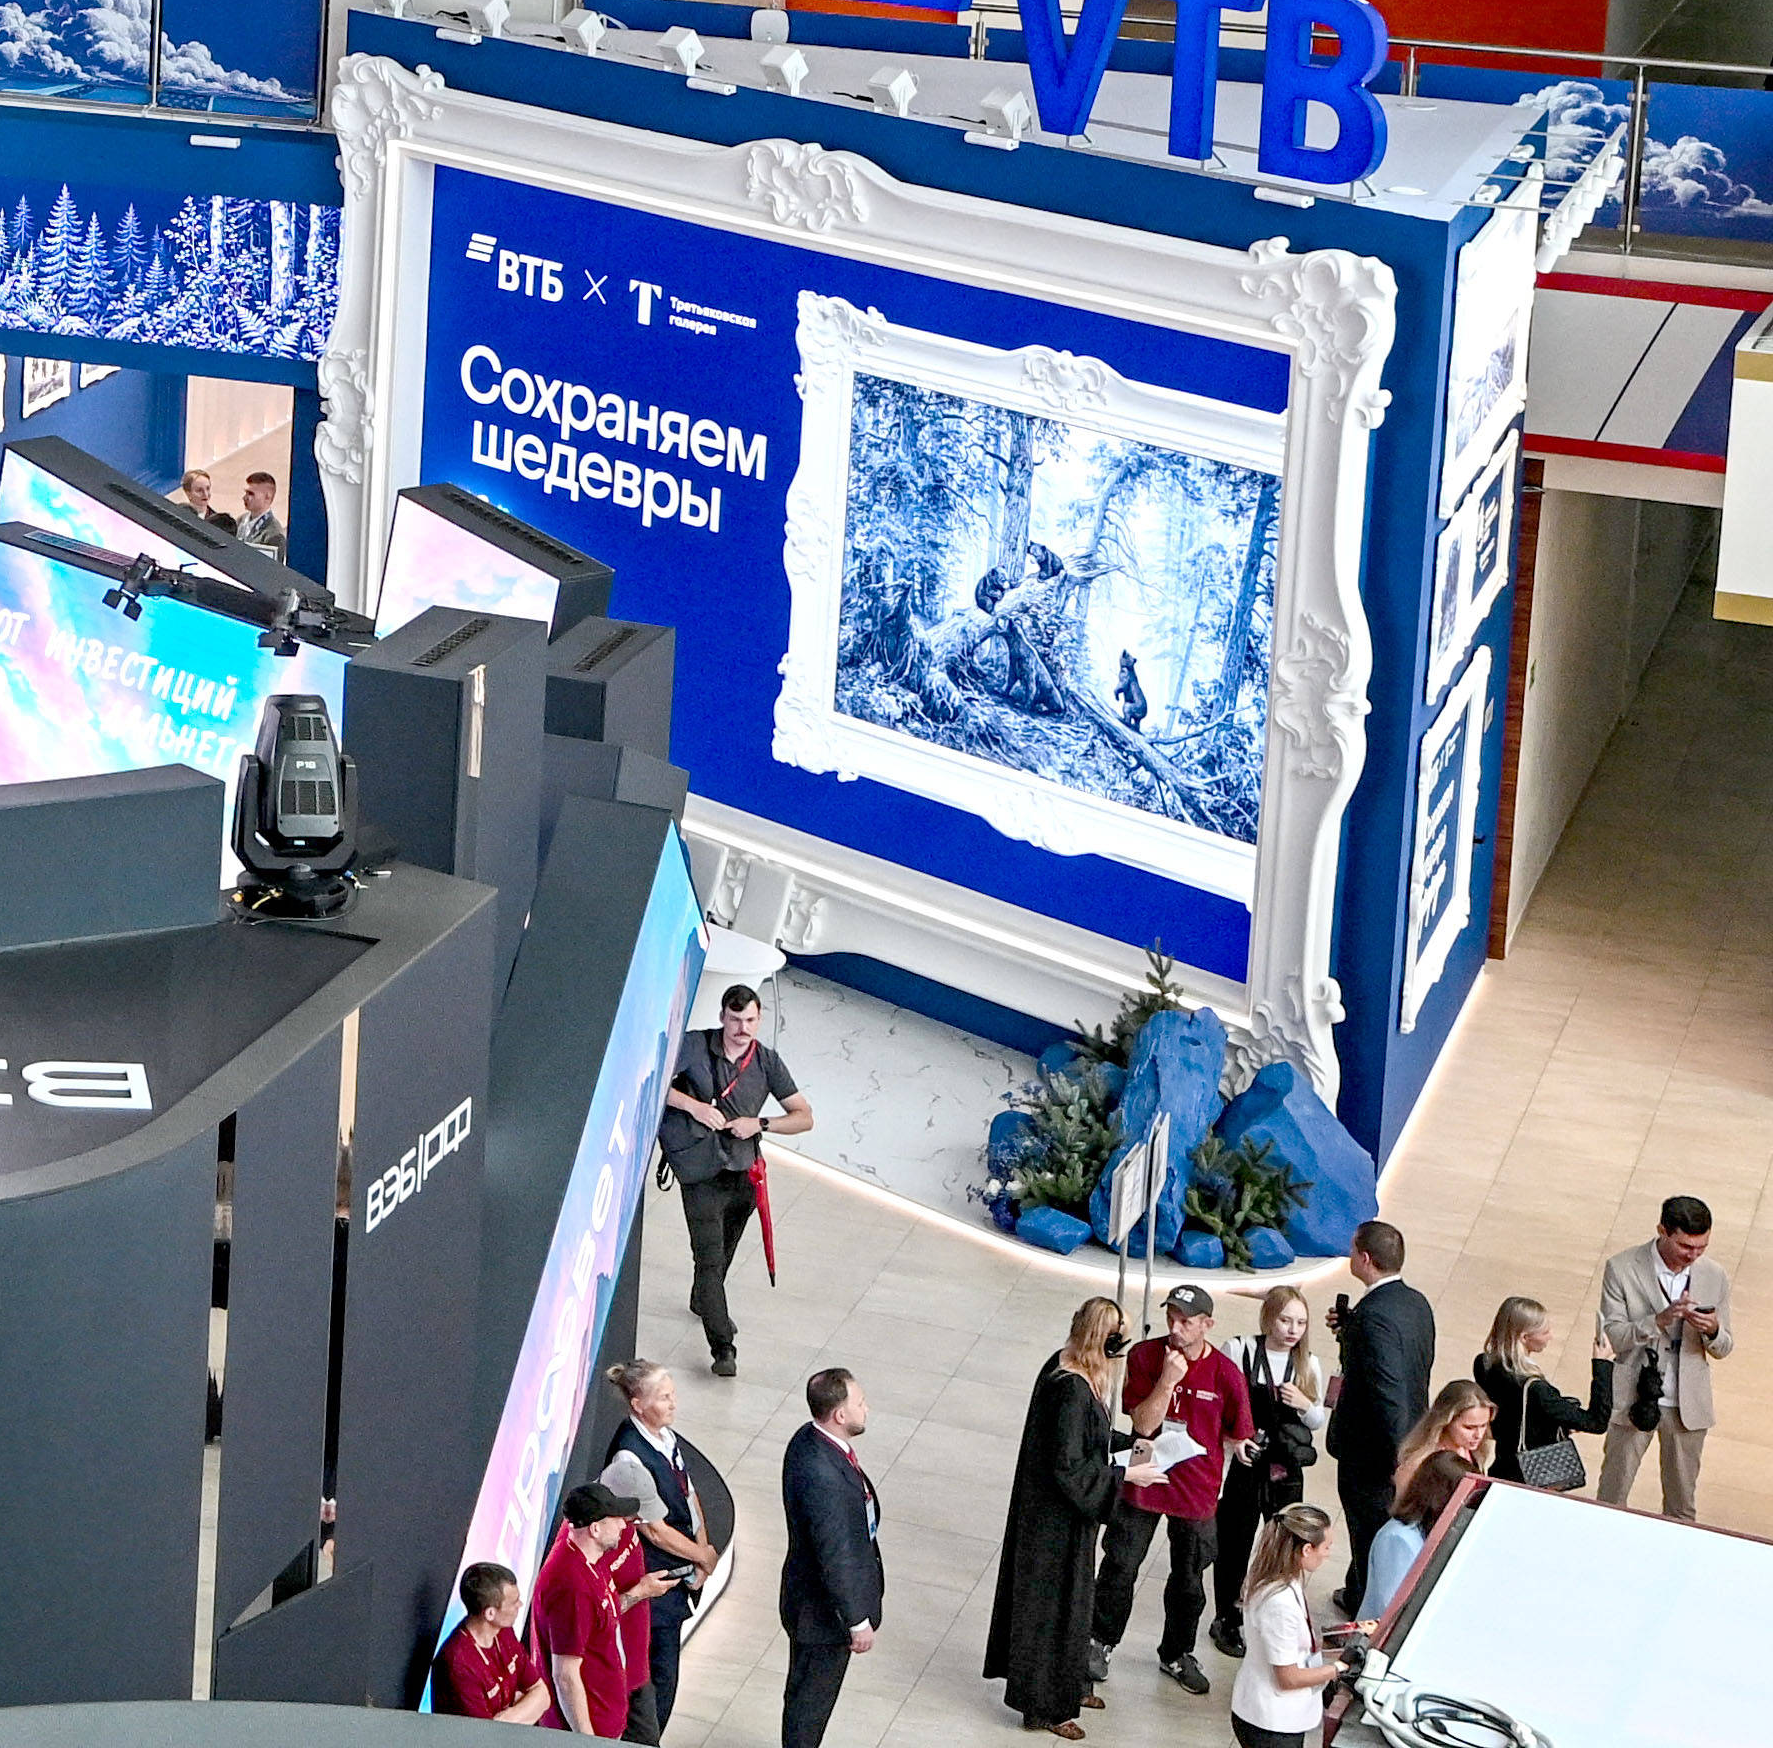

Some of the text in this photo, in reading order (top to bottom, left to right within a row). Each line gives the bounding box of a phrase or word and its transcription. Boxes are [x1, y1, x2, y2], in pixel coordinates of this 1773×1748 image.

[497, 249, 565, 303] ВТБ
[668, 296, 757, 331] Третьяковская
[668, 315, 716, 337] галерея
[460, 345, 769, 482] Сохраняем
[472, 419, 722, 533] шедевры
[45, 624, 239, 720] ИНВЕСТИЦИЙ
[365, 1096, 473, 1234] ВЭБ|РФ
